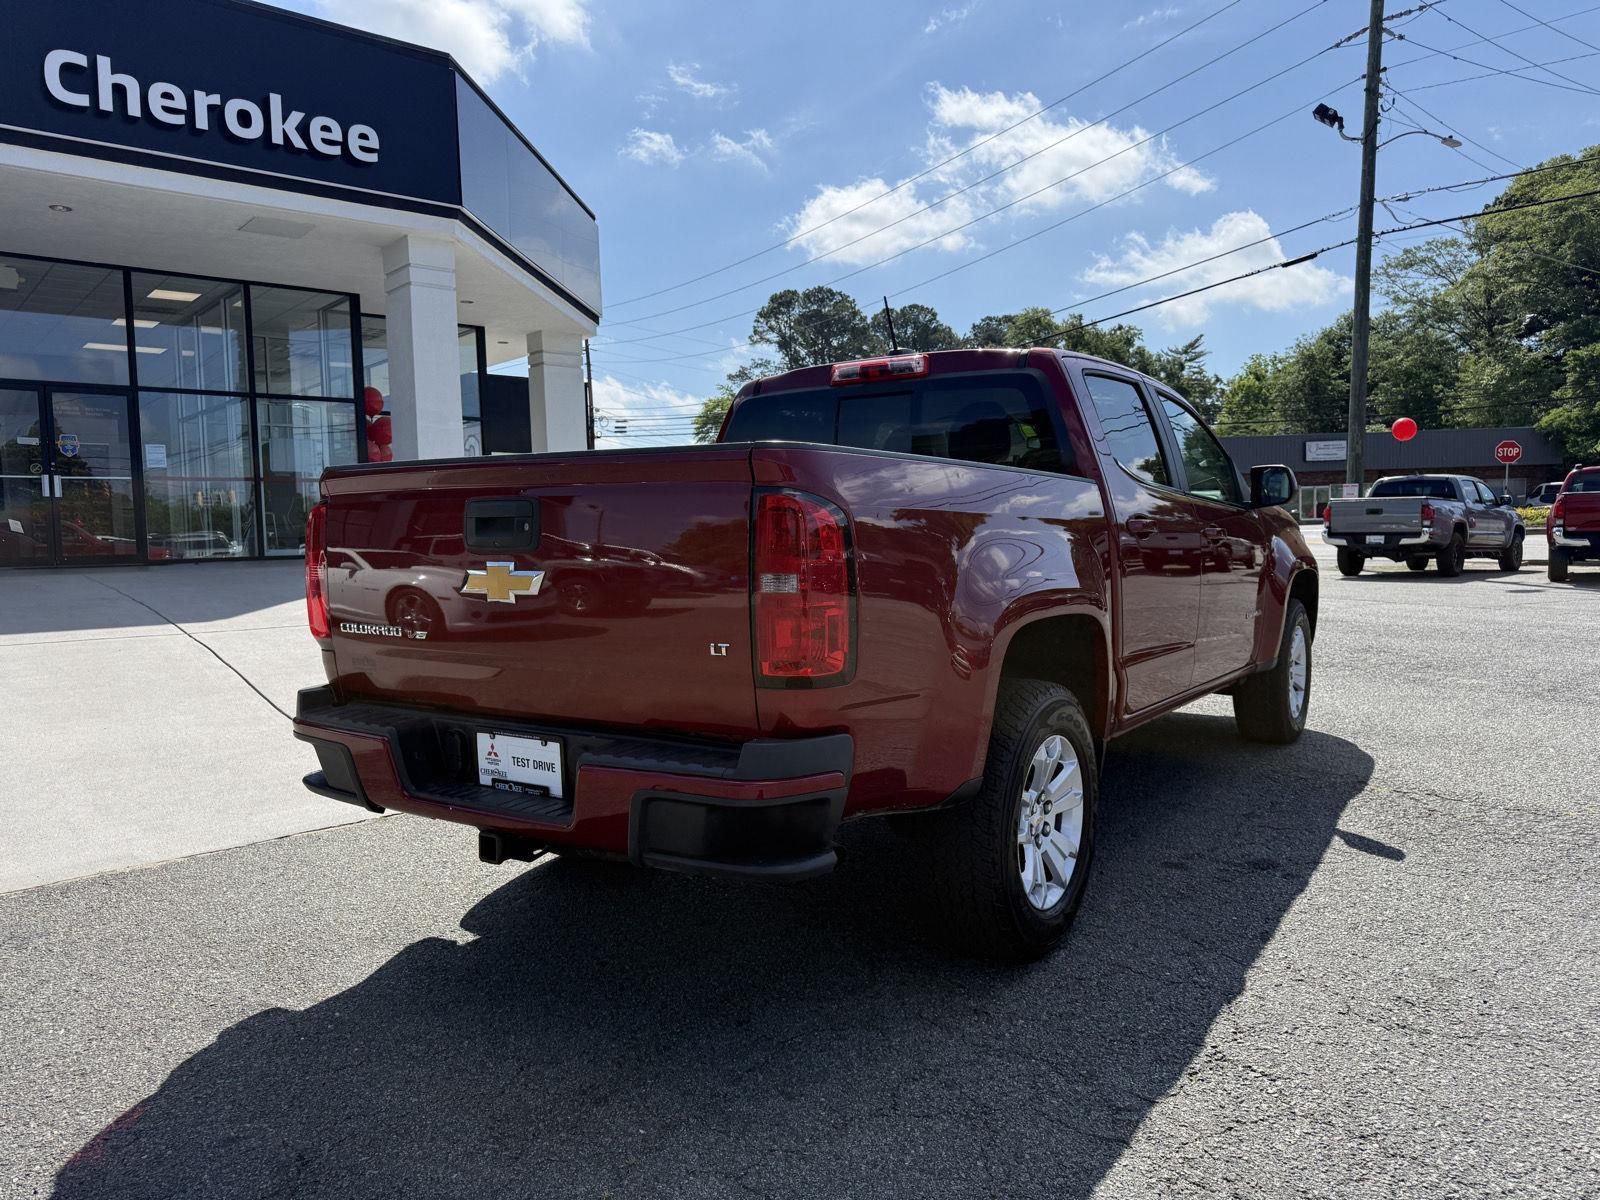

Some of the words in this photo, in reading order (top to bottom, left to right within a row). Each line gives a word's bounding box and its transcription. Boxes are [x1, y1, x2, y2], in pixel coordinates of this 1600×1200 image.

[43, 48, 381, 164] Cherokee
[1497, 447, 1520, 457] STOP
[340, 623, 402, 637] COLORADO
[710, 643, 730, 656] LT
[512, 756, 530, 768] TEST
[533, 760, 556, 773] DRIVE
